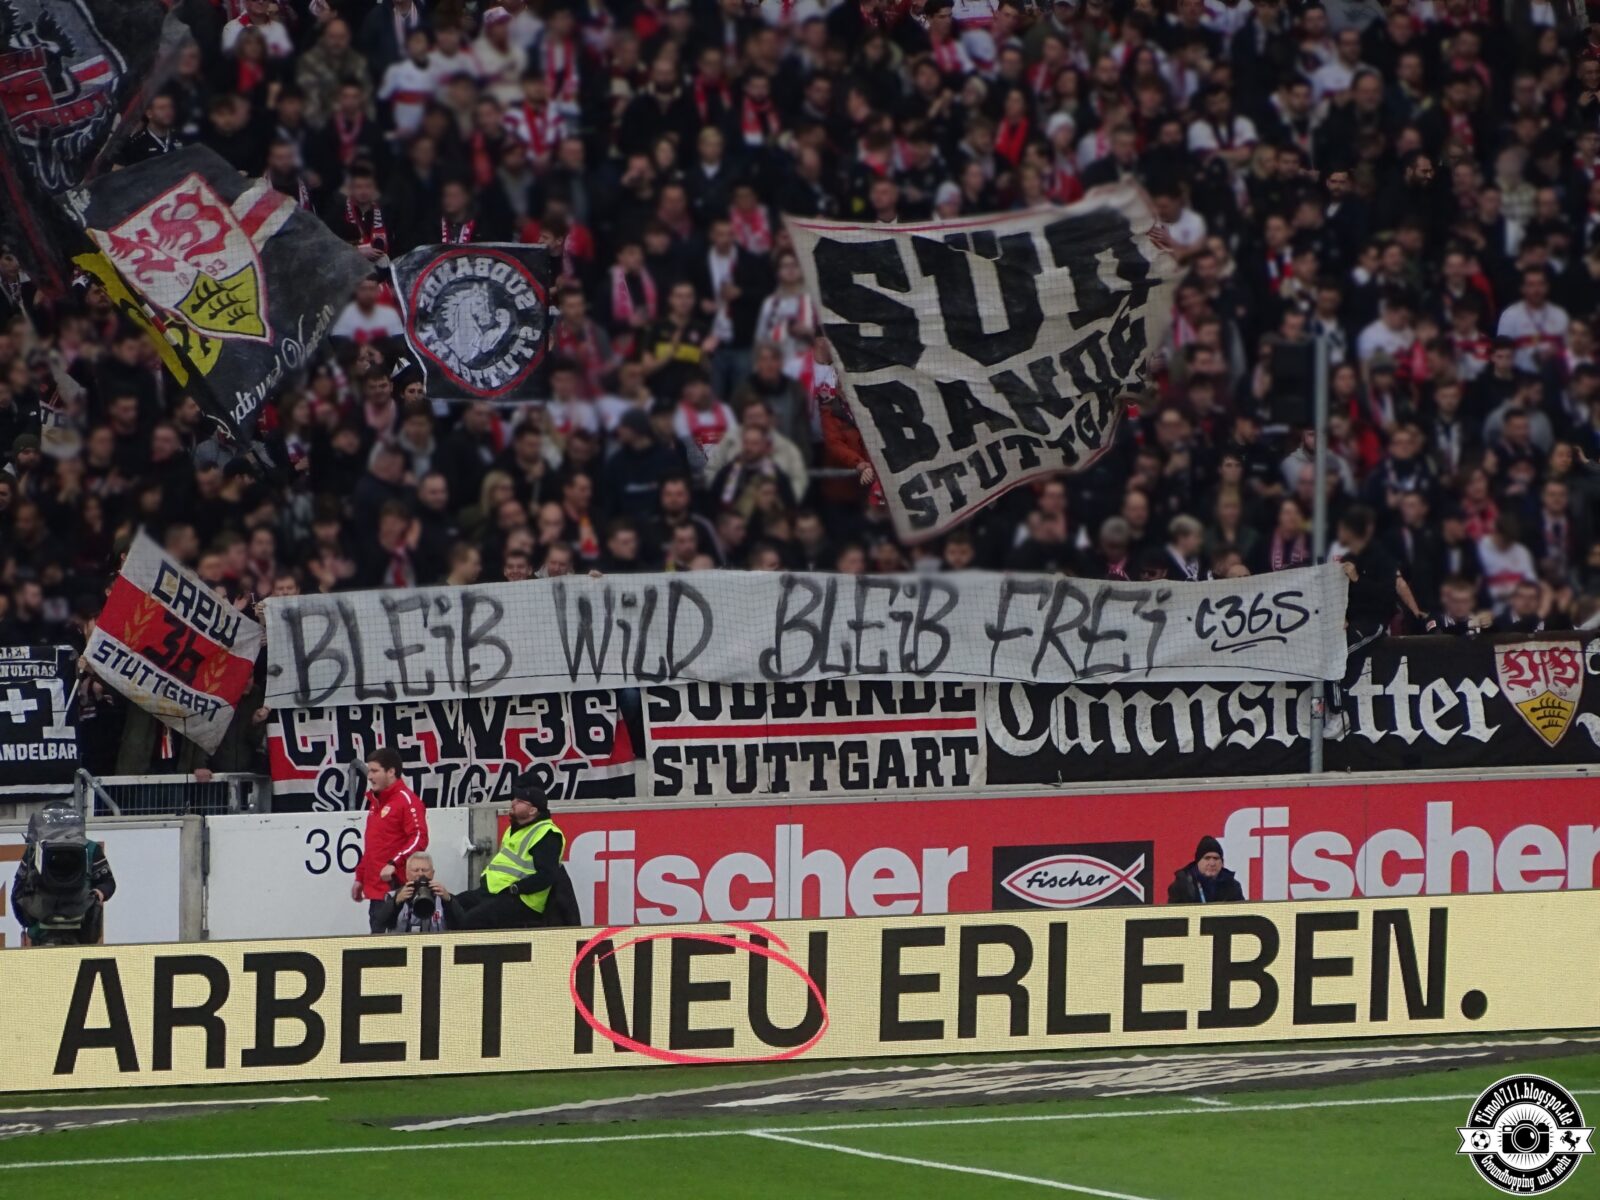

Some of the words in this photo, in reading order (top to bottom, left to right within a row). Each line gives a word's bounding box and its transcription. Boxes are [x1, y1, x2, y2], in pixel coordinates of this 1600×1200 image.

[152, 560, 241, 647] CREW
[10, 664, 56, 677] ULTRAS
[92, 639, 222, 722] STUTTGART
[141, 604, 206, 687] 36
[279, 695, 508, 766] CREW
[652, 736, 979, 797] STUTTGART
[305, 828, 362, 874] 36
[565, 823, 969, 925] fischer
[1026, 871, 1110, 888] fischer
[53, 943, 533, 1076] ARBEIT
[573, 931, 829, 1055] NEU
[879, 906, 1488, 1042] ERLEBEN.
